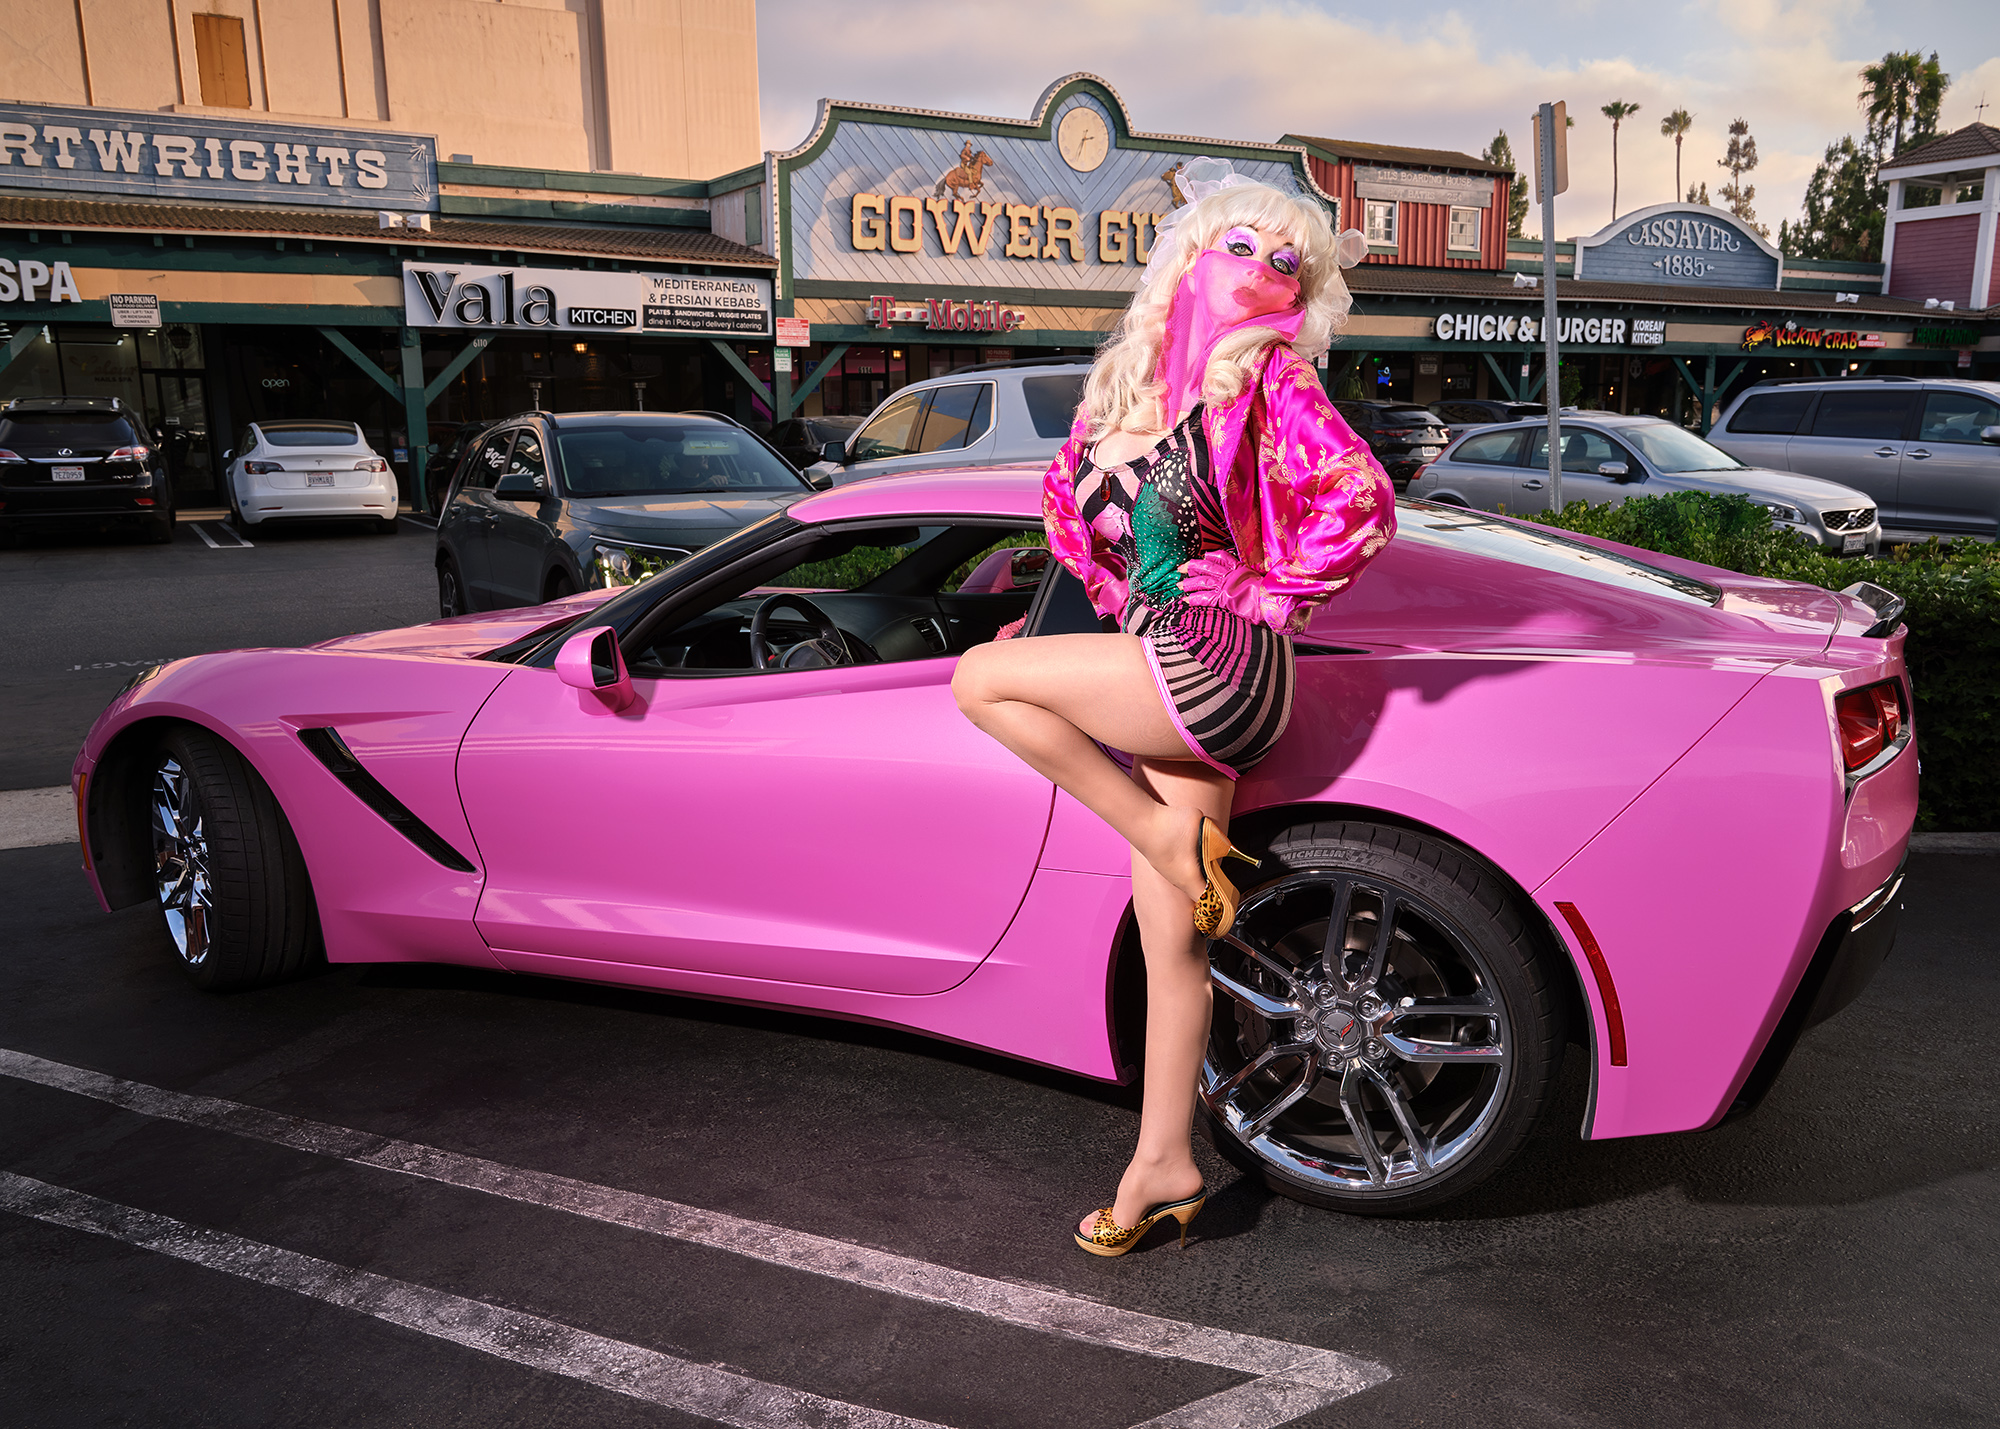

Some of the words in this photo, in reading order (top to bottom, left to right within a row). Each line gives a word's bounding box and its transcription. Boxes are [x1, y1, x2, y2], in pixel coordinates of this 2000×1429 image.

[1401, 172, 1442, 185] BOARDING
[1446, 177, 1472, 187] HOUSE
[1408, 190, 1435, 200] BATHS
[852, 192, 1085, 261] GOWER
[1628, 219, 1741, 252] ASSAYER
[1663, 254, 1705, 277] 1885
[0, 257, 83, 303] SPA
[654, 278, 756, 293] MEDITERRANEAN
[112, 296, 124, 304] NO
[124, 296, 156, 304] PARKING
[411, 268, 560, 327] Vala
[649, 293, 657, 304] &
[660, 294, 711, 306] PERSIAN
[715, 297, 761, 309] KEBABS
[571, 309, 635, 325] KITCHEN
[648, 308, 671, 316] PLATES
[674, 310, 715, 318] SANDWICHES
[676, 318, 691, 326] Pick
[705, 320, 731, 329] delivery
[736, 321, 762, 331] catering
[1436, 313, 1514, 342] CHICK
[1517, 315, 1536, 342] &
[1540, 316, 1625, 344] URGER
[1633, 319, 1665, 332] KOREAN
[473, 339, 488, 348] 6110
[1631, 332, 1664, 345] KITCHEN
[1825, 331, 1858, 350] CRAB
[1916, 327, 1944, 344] HENRY
[1944, 328, 1981, 345] PRINTING
[262, 379, 290, 389] open
[1280, 849, 1346, 861] MICHELIN
